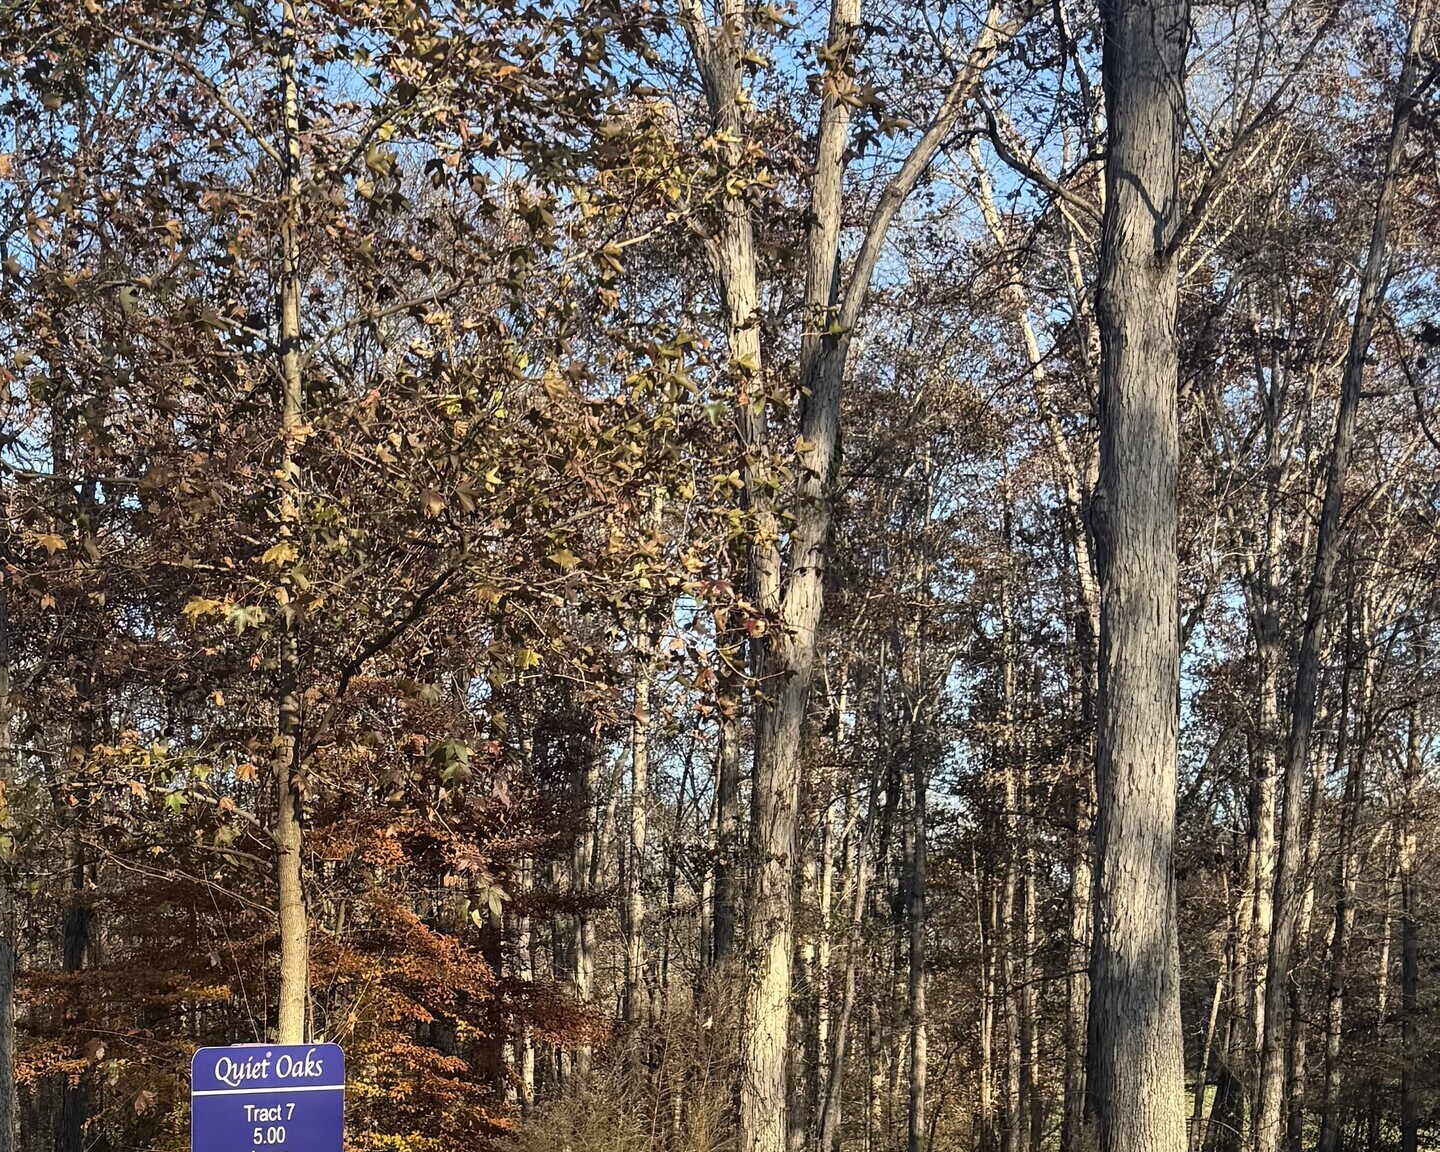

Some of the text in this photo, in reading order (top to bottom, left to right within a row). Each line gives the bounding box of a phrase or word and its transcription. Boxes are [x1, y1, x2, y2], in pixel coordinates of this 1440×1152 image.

[215, 1048, 323, 1087] Quiet Oaks
[244, 1103, 295, 1122] Tract 7
[253, 1126, 286, 1144] 5.00
